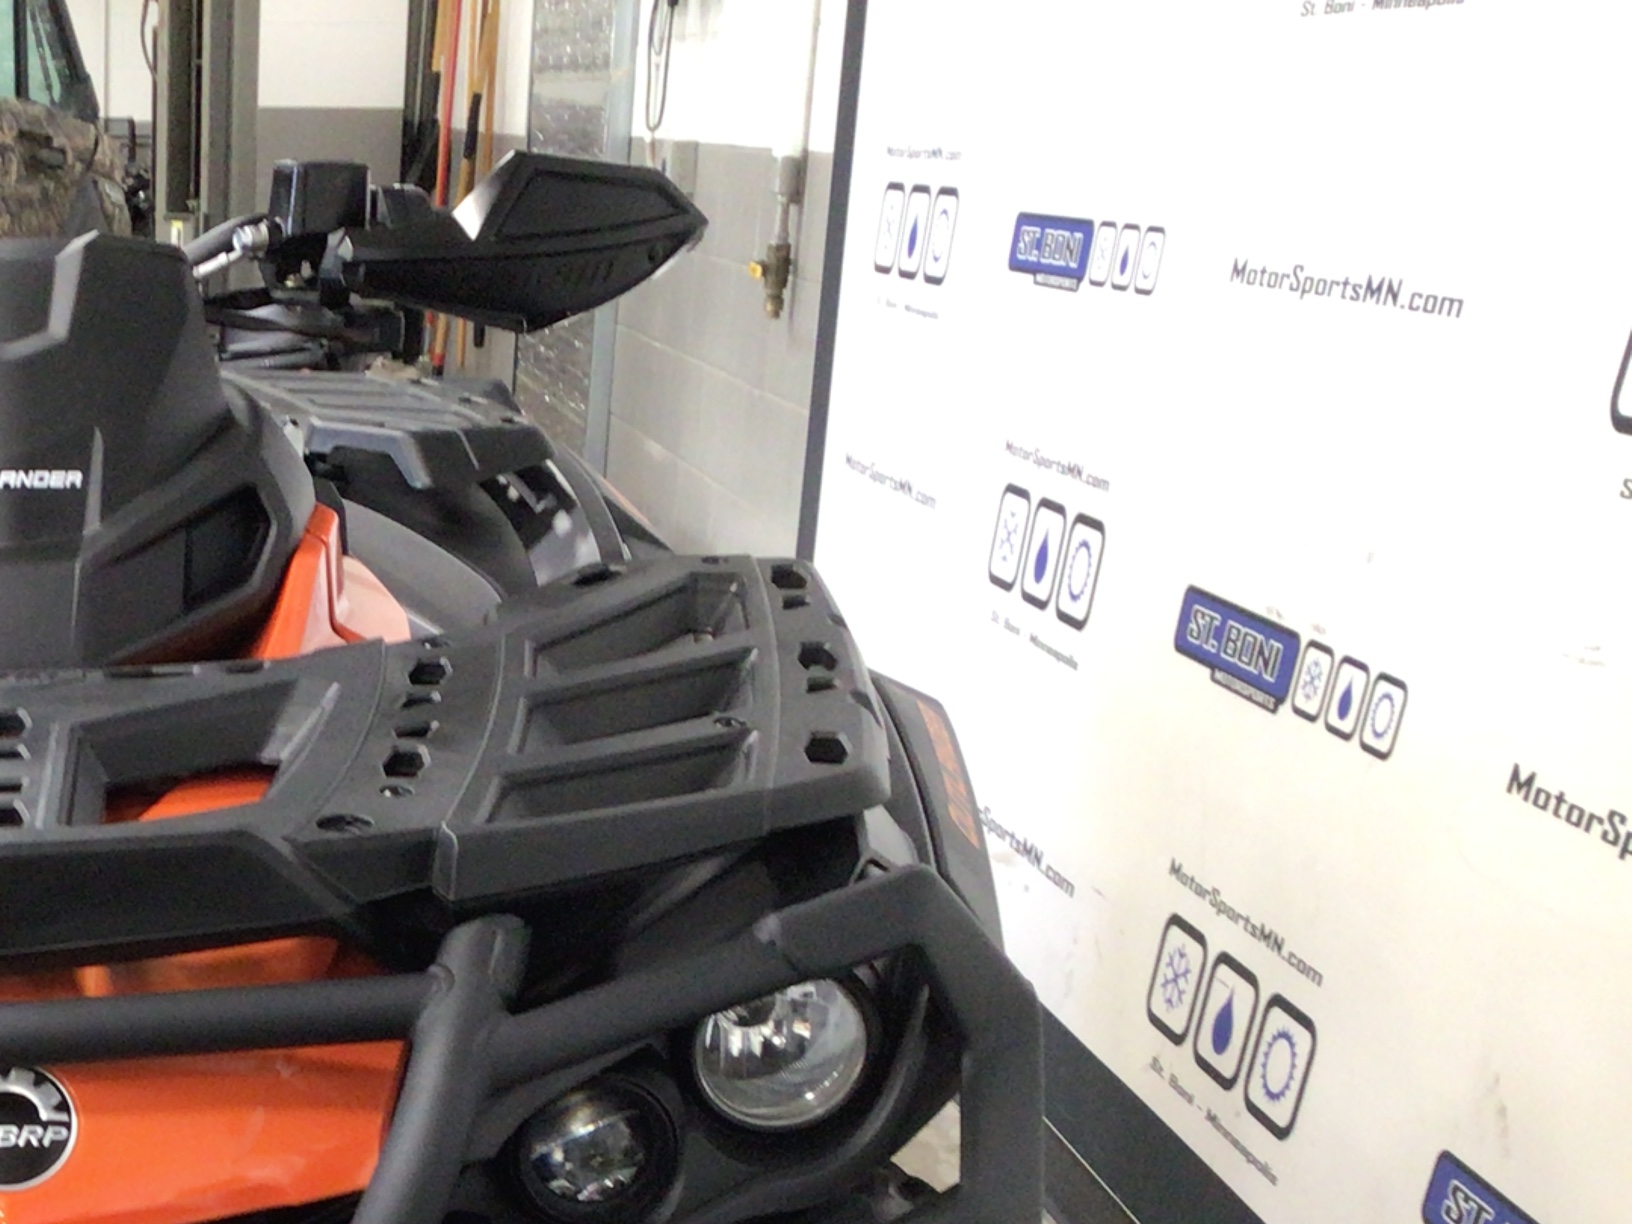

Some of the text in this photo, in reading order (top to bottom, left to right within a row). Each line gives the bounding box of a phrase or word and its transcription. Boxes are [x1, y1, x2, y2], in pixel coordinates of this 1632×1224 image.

[1040, 227, 1084, 269] BONI
[1230, 257, 1464, 319] MotorSportsMN.com
[1004, 439, 1111, 493] MotorSportsMN.com
[1187, 604, 1284, 683] ST. BONI
[1168, 857, 1324, 988] MotorSportsMN.com
